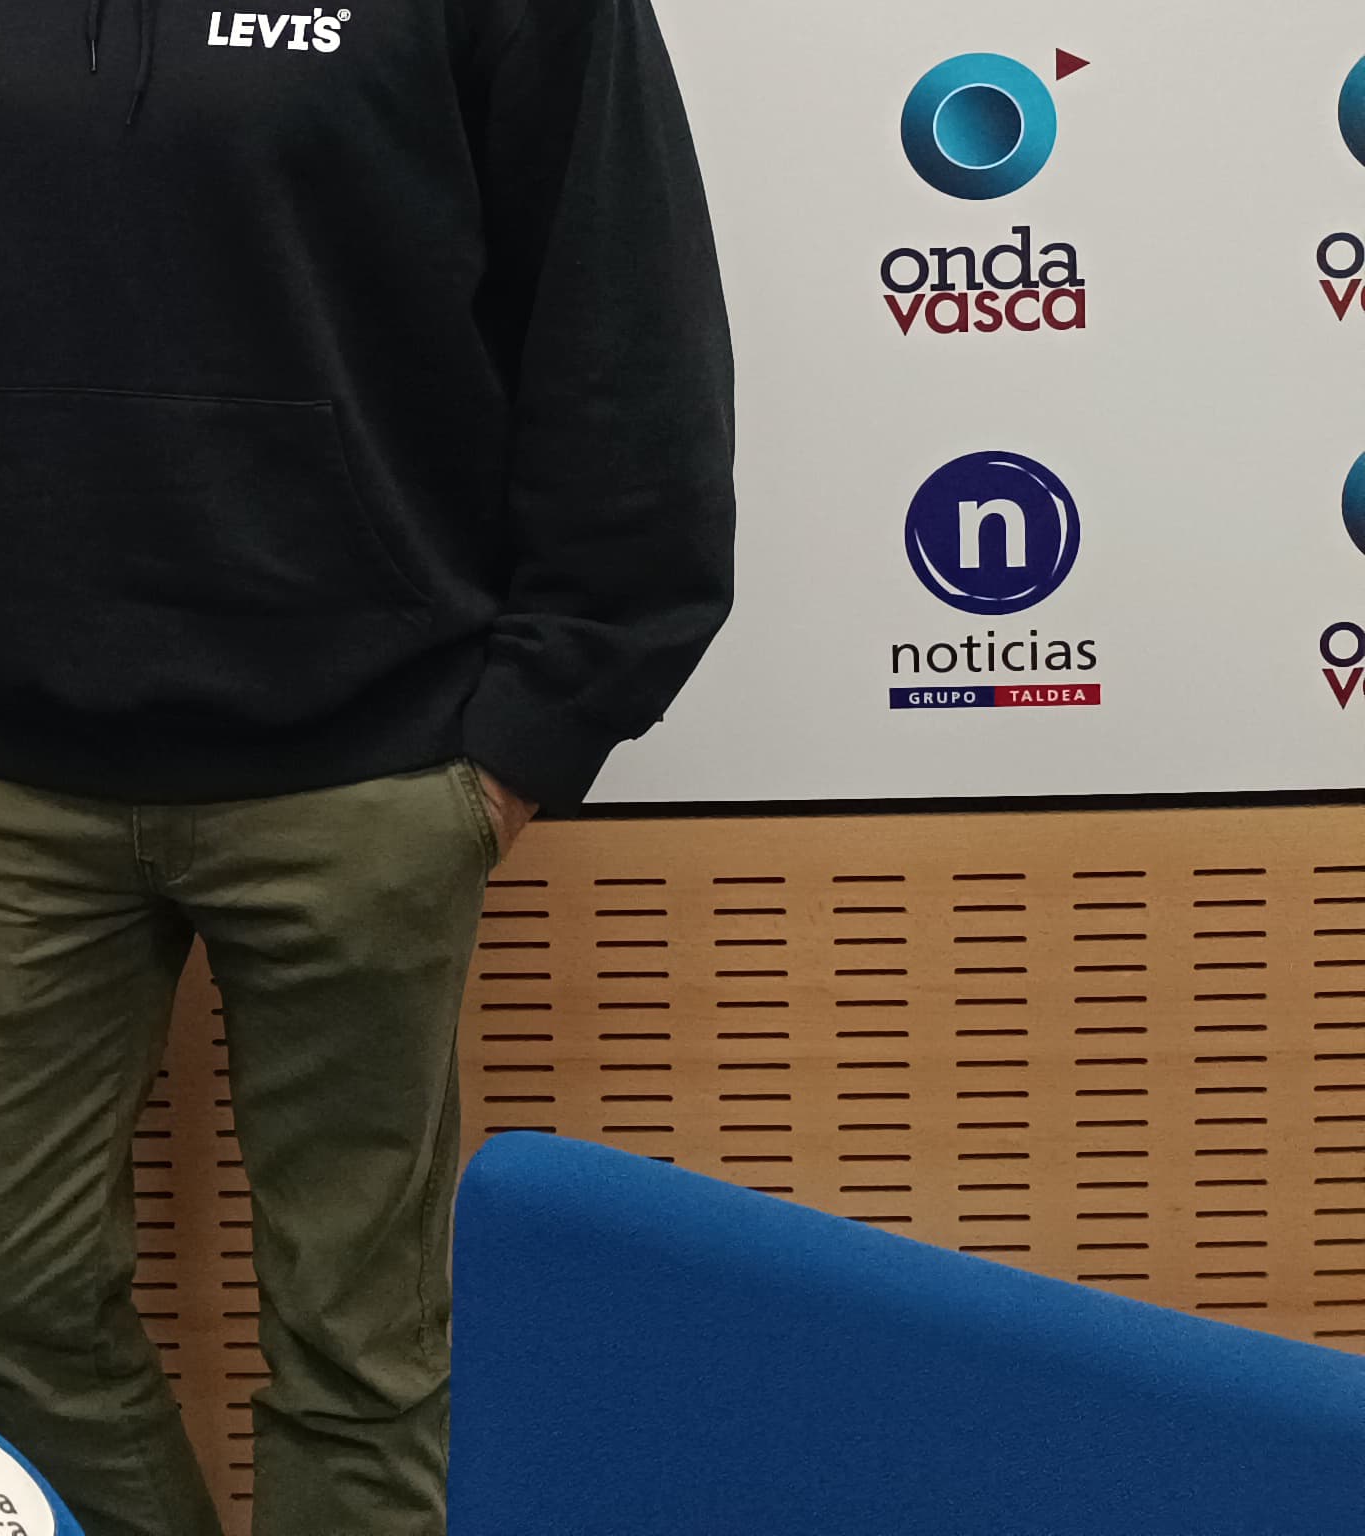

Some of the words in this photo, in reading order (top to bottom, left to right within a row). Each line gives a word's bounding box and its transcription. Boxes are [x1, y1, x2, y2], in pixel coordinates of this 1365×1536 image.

[880, 226, 1086, 294] onda
[884, 288, 1087, 335] vasca
[891, 629, 1098, 674] noticias
[908, 691, 977, 705] GRUPO
[1009, 689, 1087, 703] TALDEA
